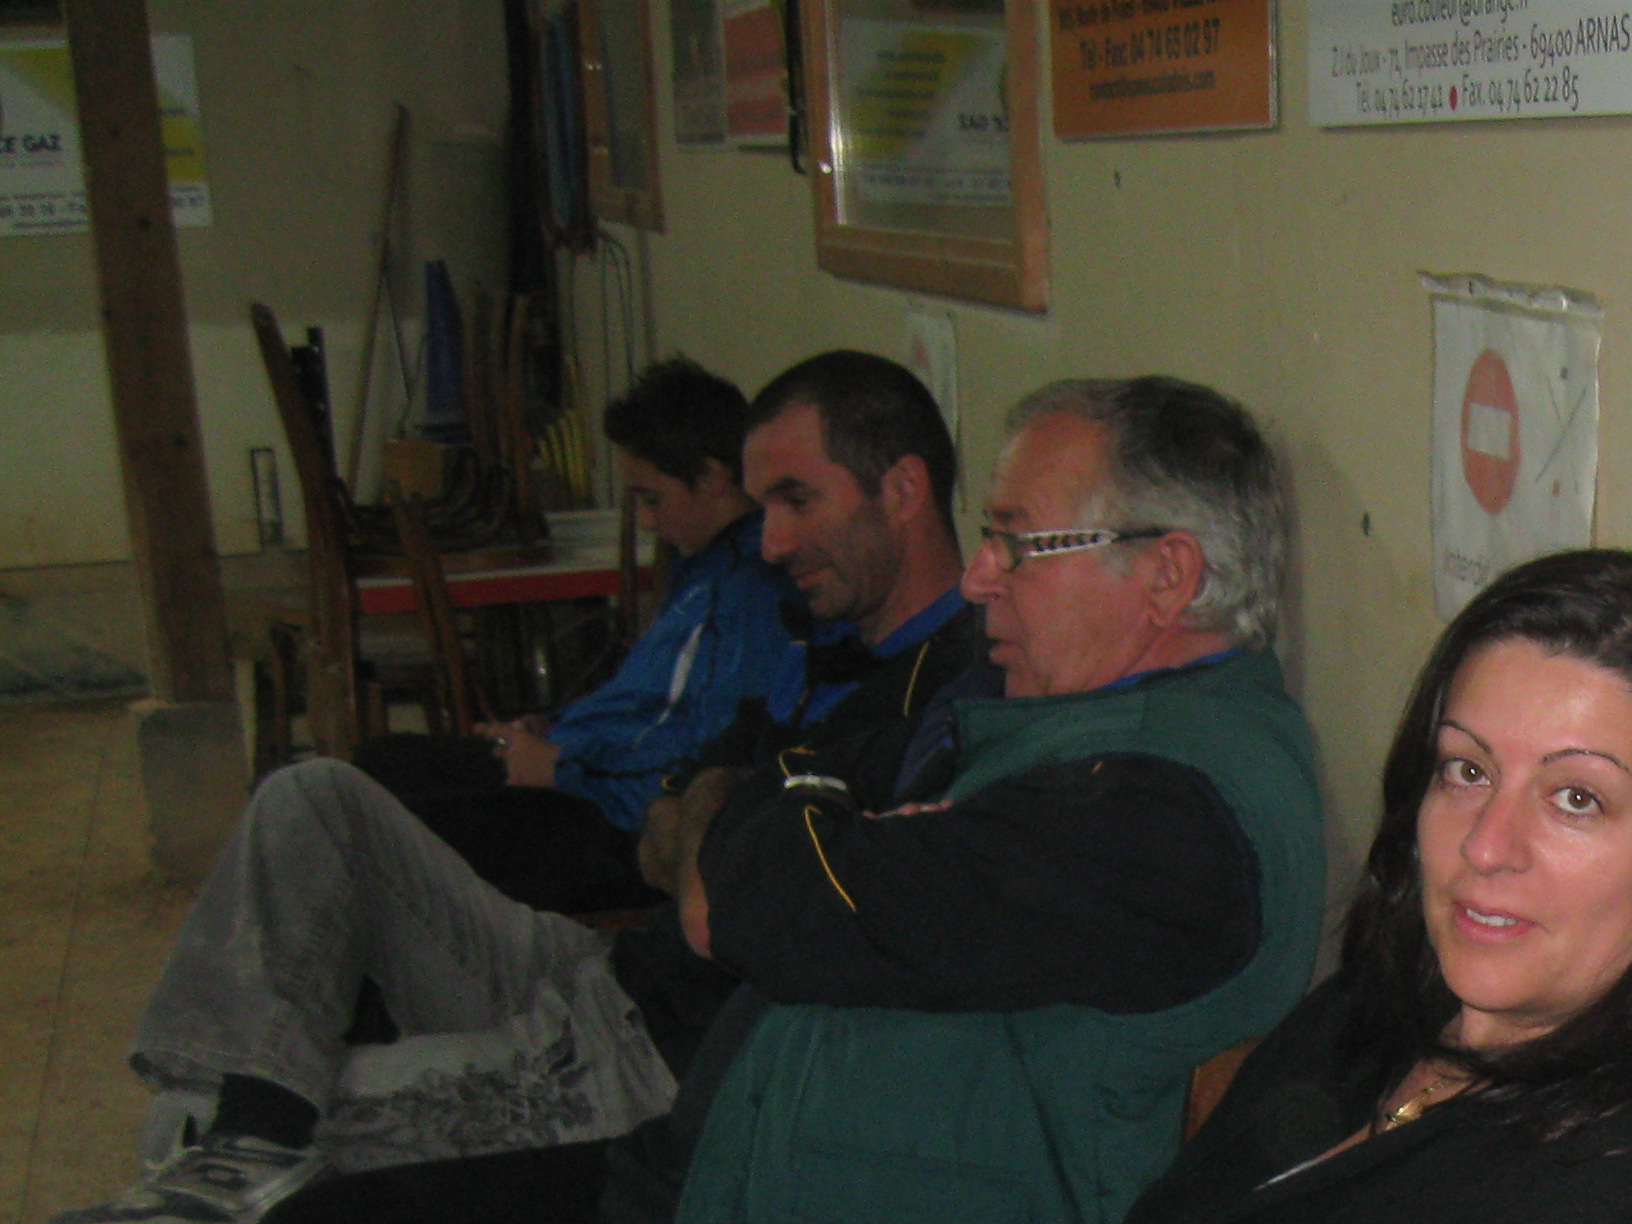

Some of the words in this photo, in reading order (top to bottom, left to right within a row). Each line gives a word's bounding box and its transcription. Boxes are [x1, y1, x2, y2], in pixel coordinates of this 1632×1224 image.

[1450, 30, 1471, 67] des
[1473, 27, 1519, 63] Prairies
[1530, 23, 1573, 68] 69400
[1575, 13, 1631, 56] ARNAS
[1488, 79, 1504, 112] 04
[1507, 79, 1520, 112] 74
[1524, 66, 1540, 103] 62
[1544, 75, 1558, 102] 22
[1562, 65, 1579, 111] 85
